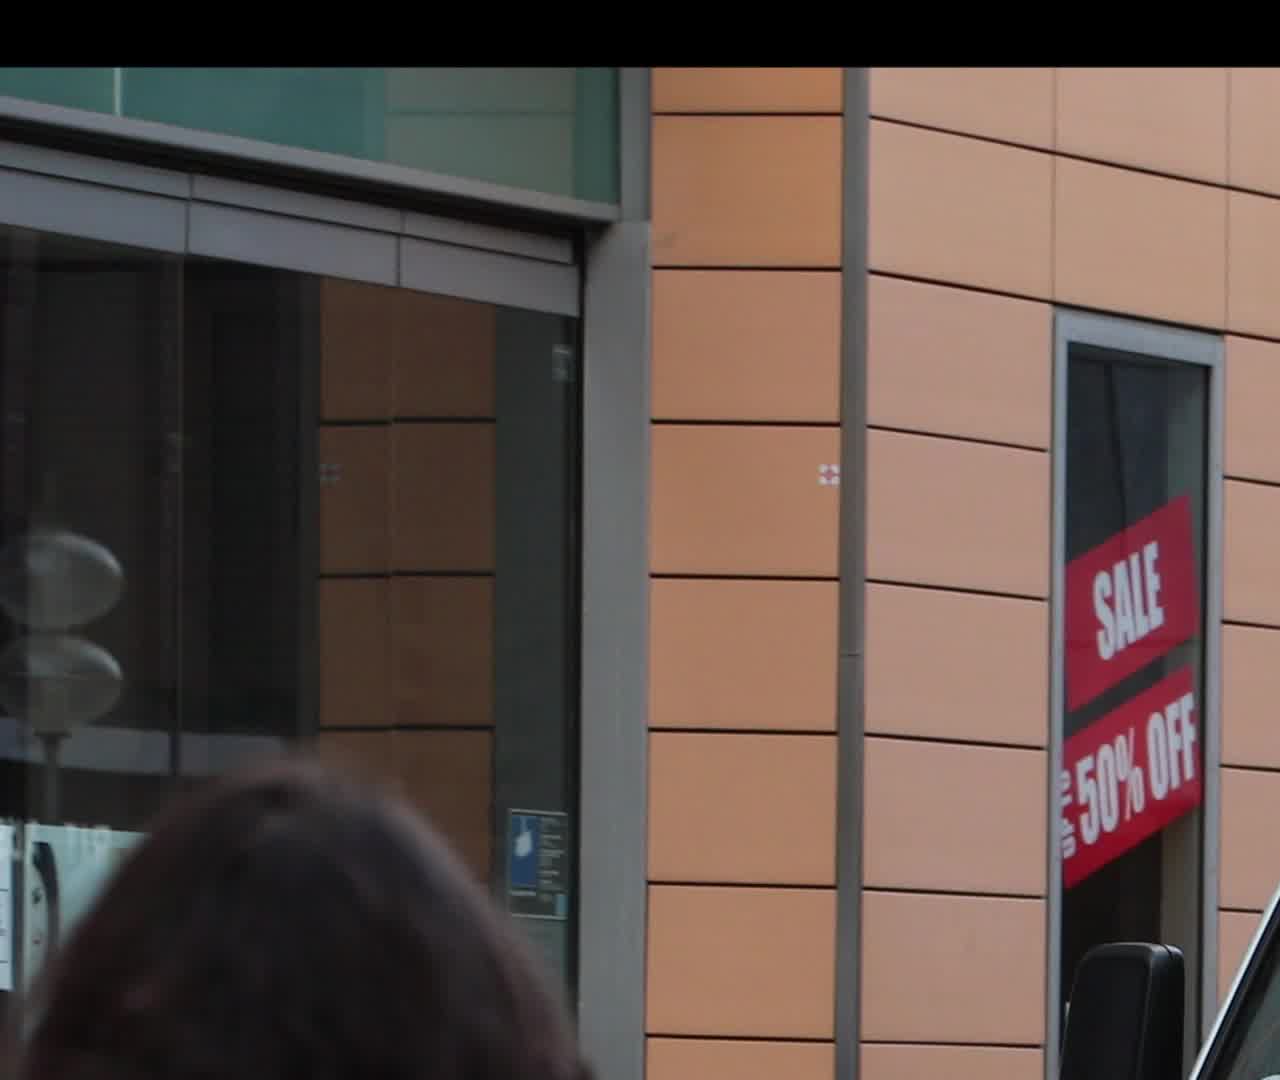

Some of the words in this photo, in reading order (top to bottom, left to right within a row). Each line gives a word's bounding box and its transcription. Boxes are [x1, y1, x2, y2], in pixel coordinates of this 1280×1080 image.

[1093, 541, 1164, 661] SALE
[1076, 727, 1145, 845] 50%
[1146, 693, 1196, 801] OFF
